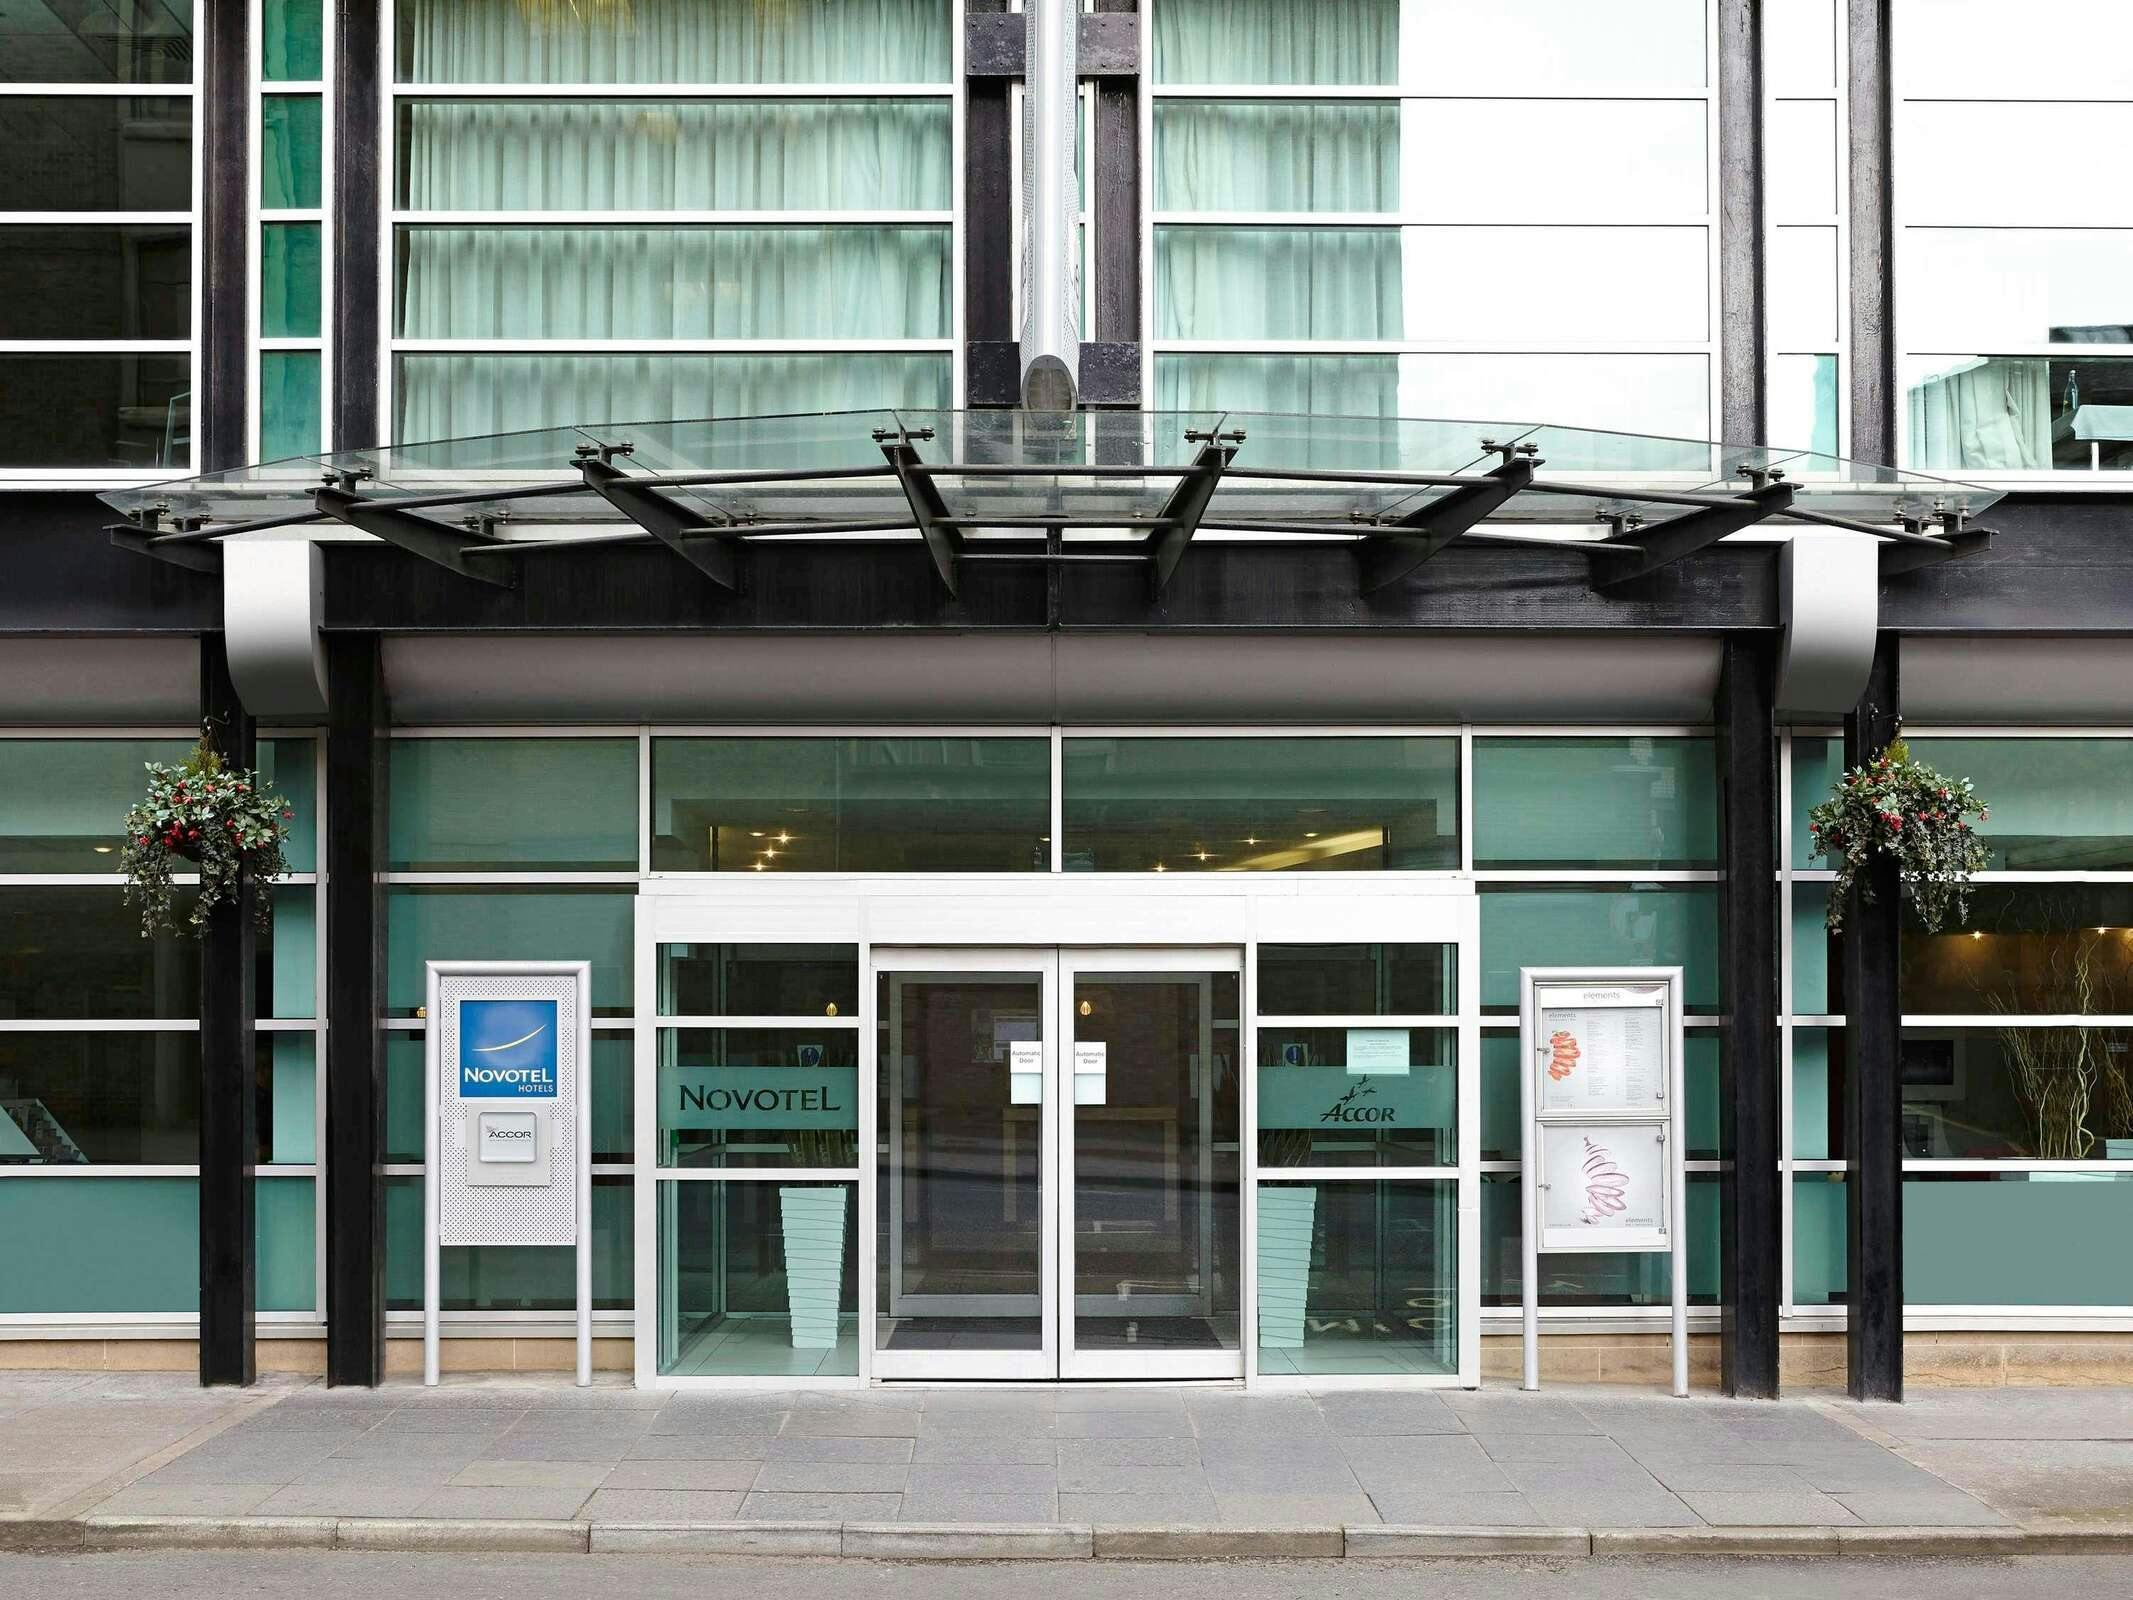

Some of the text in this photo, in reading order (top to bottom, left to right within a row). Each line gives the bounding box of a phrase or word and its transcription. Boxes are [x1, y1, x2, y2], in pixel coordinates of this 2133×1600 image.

[1583, 991, 1621, 1000] elements
[464, 1067, 553, 1083] NOVOTEL
[518, 1084, 553, 1092] HOTELS
[679, 1085, 841, 1111] NOVOTEL
[1320, 1103, 1396, 1122] ACCOR
